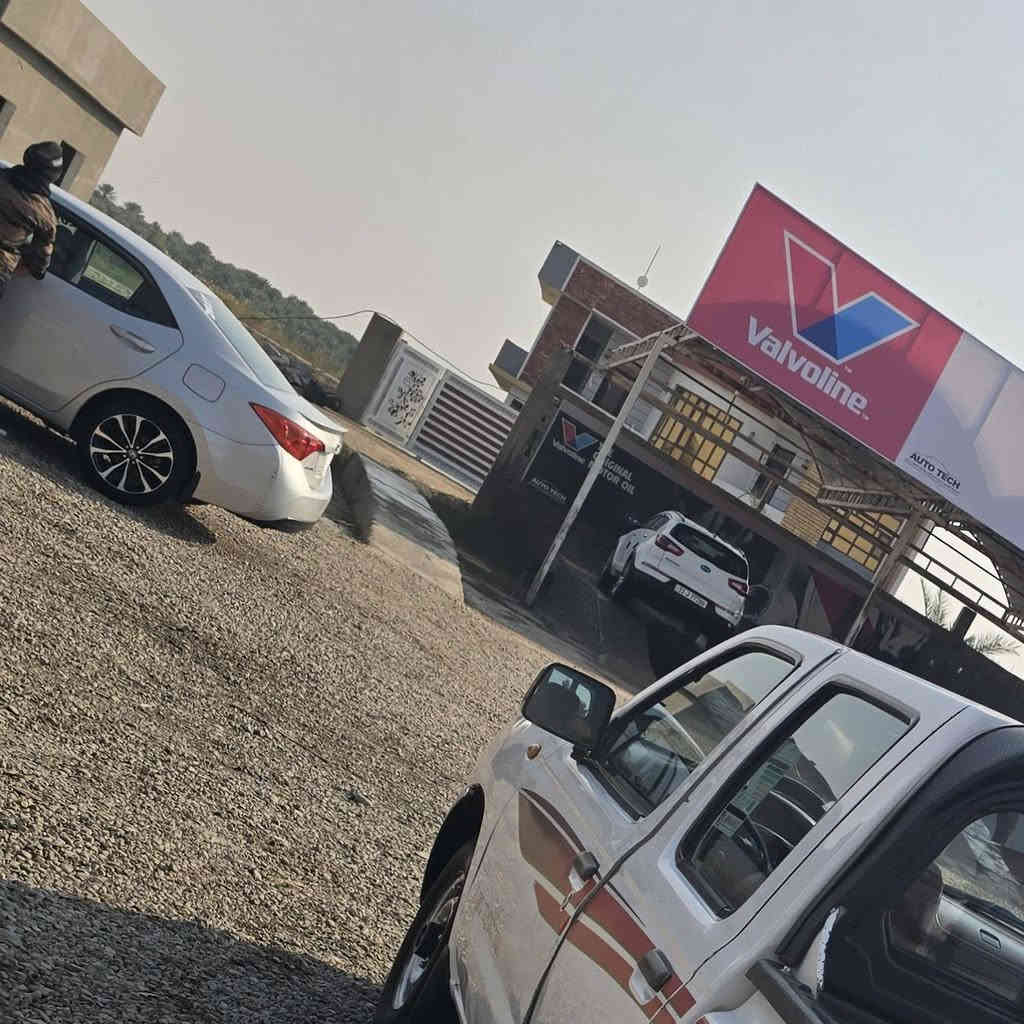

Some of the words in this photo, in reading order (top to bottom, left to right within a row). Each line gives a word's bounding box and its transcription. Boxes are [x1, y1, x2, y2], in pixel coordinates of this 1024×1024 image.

[748, 315, 869, 415] Valvoline
[910, 452, 937, 476] AUTO
[936, 468, 961, 490] TECH
